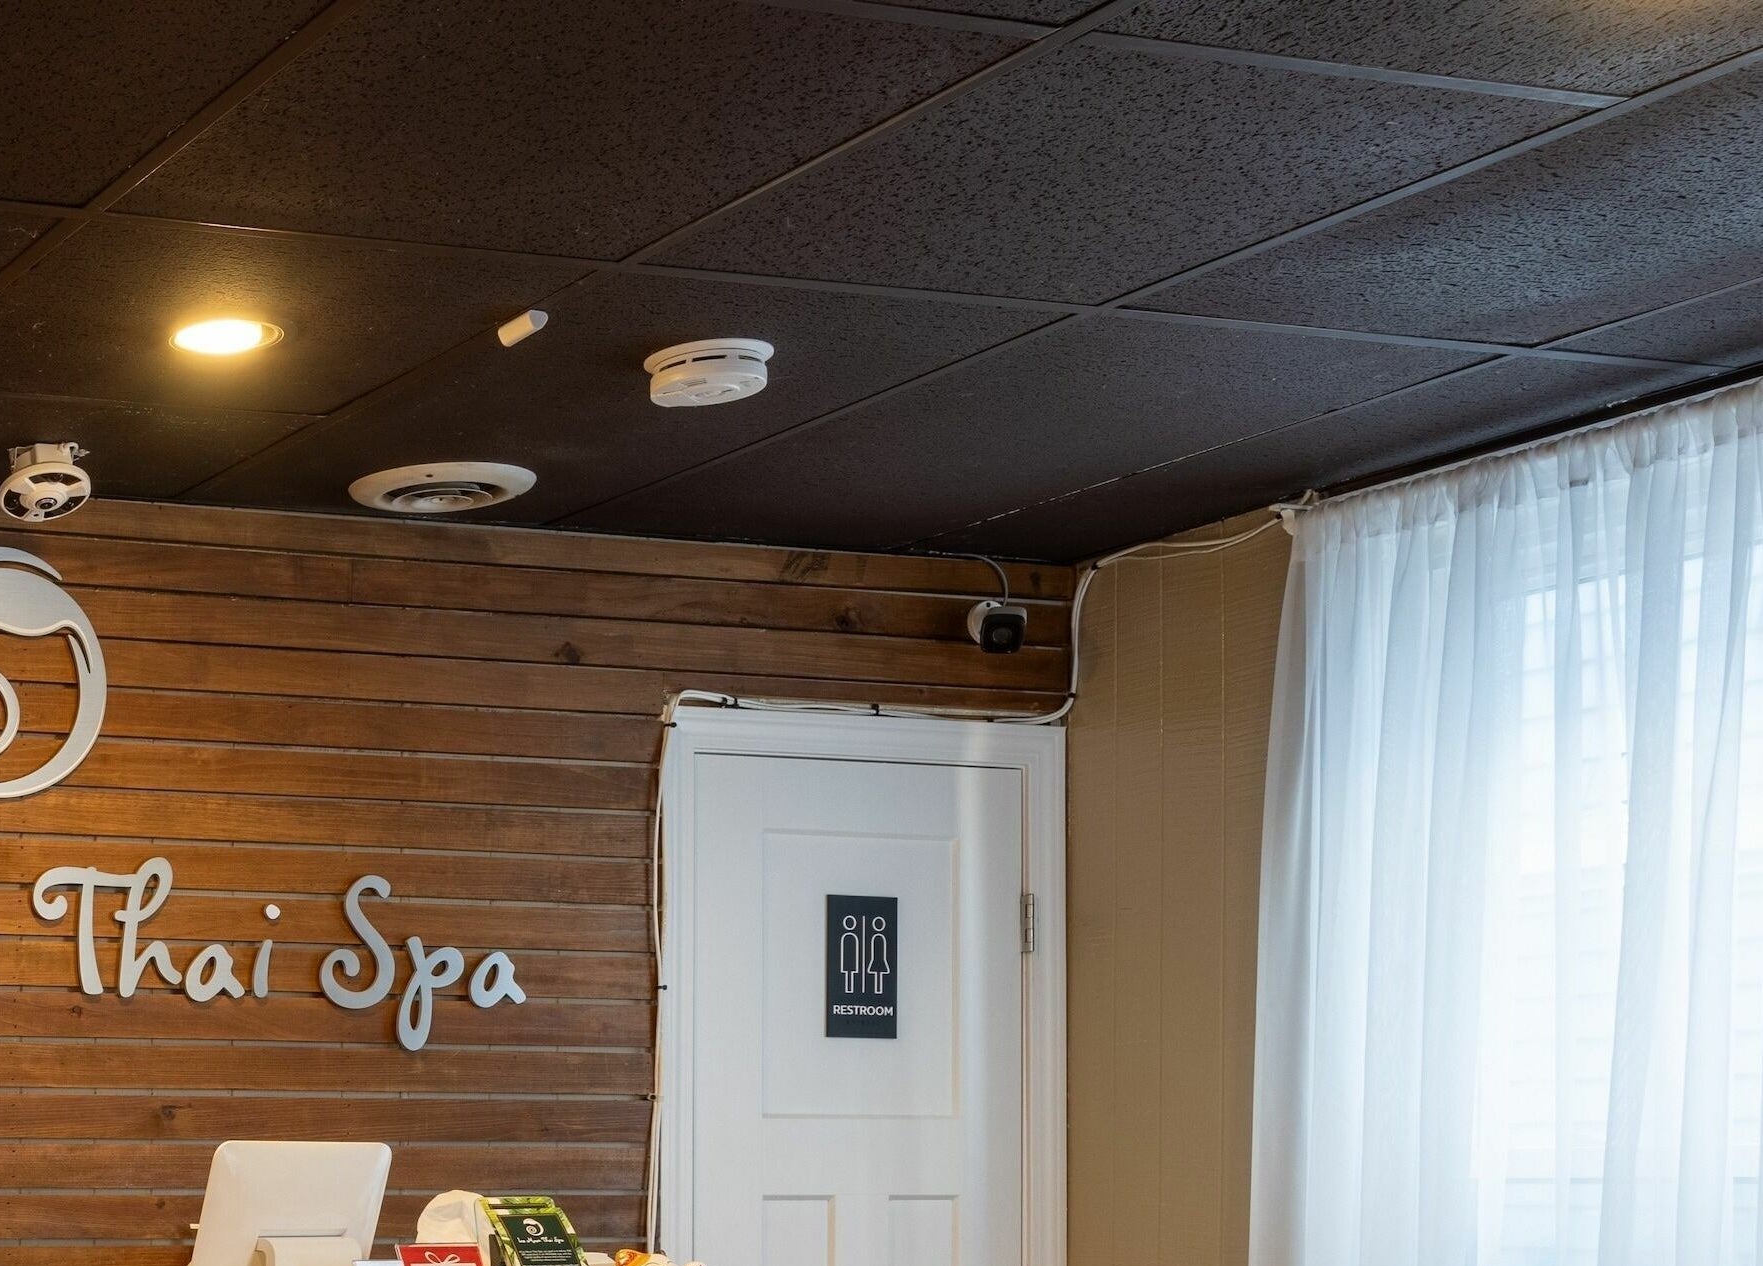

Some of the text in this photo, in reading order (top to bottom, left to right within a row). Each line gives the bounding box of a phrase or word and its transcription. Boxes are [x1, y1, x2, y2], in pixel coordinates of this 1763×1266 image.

[32, 856, 280, 1003] Thai
[318, 874, 527, 1052] Spa
[833, 1004, 894, 1016] RESTROOM
